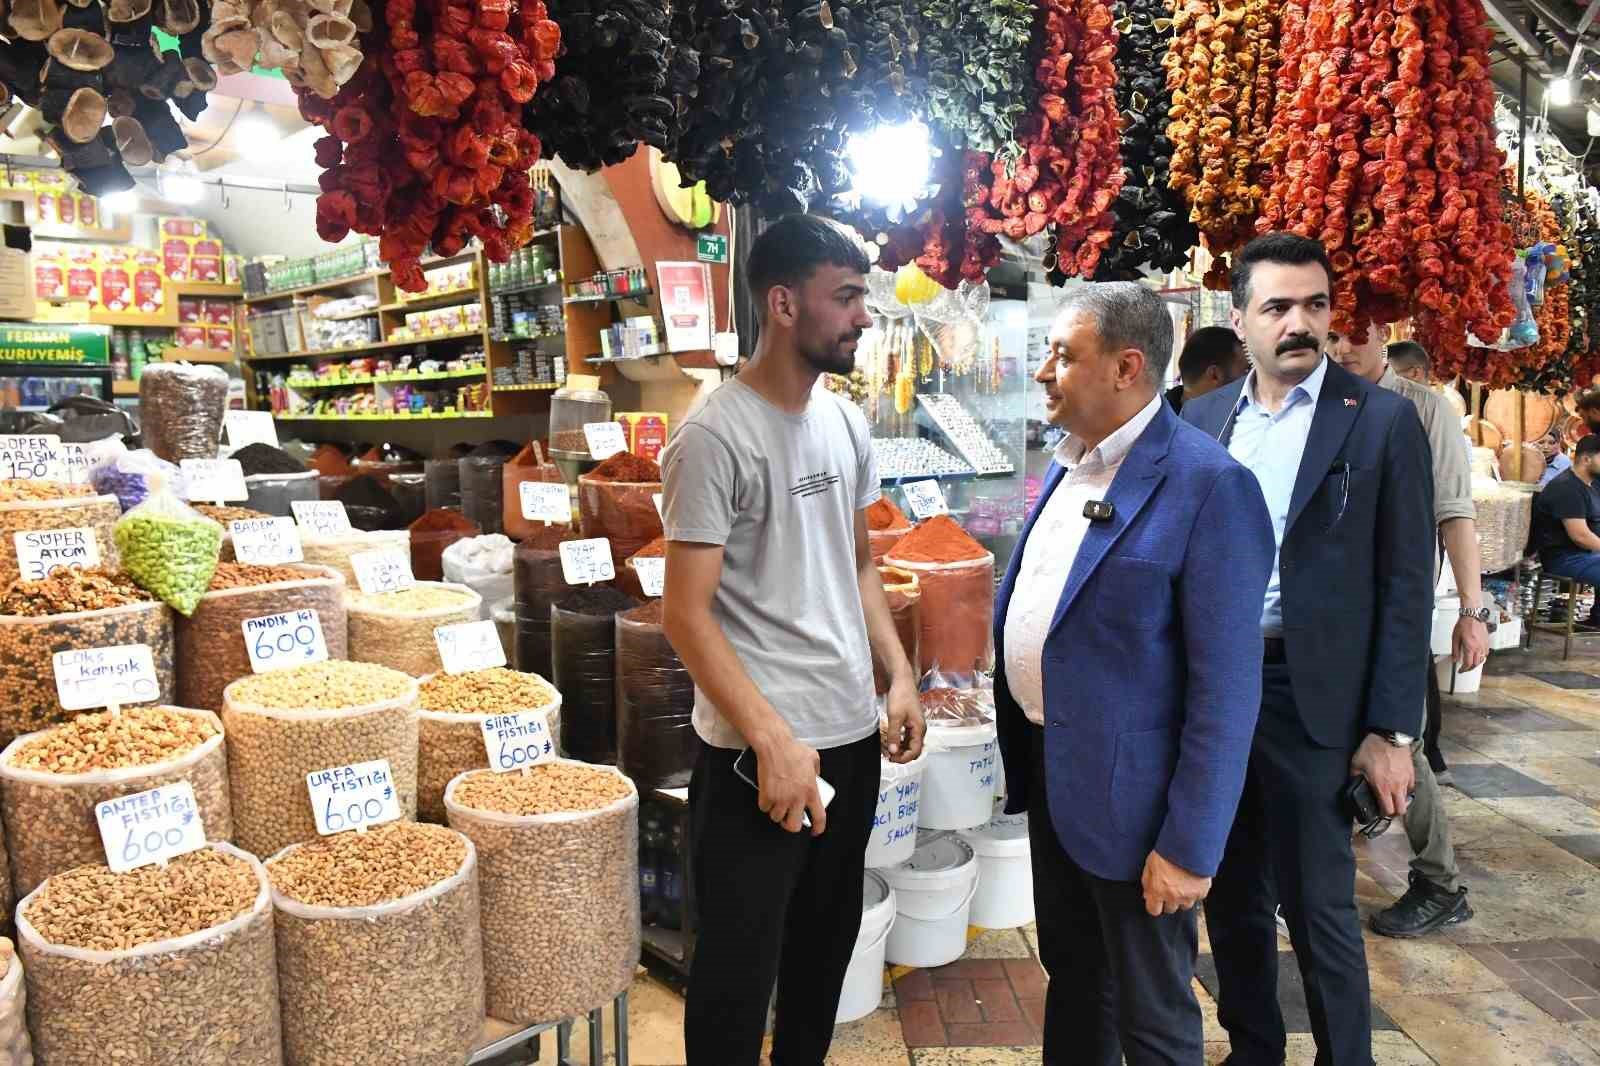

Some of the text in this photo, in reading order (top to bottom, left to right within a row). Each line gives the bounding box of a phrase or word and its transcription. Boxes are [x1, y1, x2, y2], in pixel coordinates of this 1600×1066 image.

[706, 241, 719, 255] 7H
[2, 450, 57, 465] ARIŞIK
[7, 461, 48, 480] 150
[26, 531, 86, 547] SÜPER
[40, 547, 87, 560] ATOM
[255, 624, 316, 660] 600
[499, 742, 540, 769] 600
[310, 766, 356, 787] URFA
[101, 790, 161, 819] ANTEP
[879, 791, 888, 803] V
[325, 797, 383, 831] 600
[122, 828, 184, 862] 600
